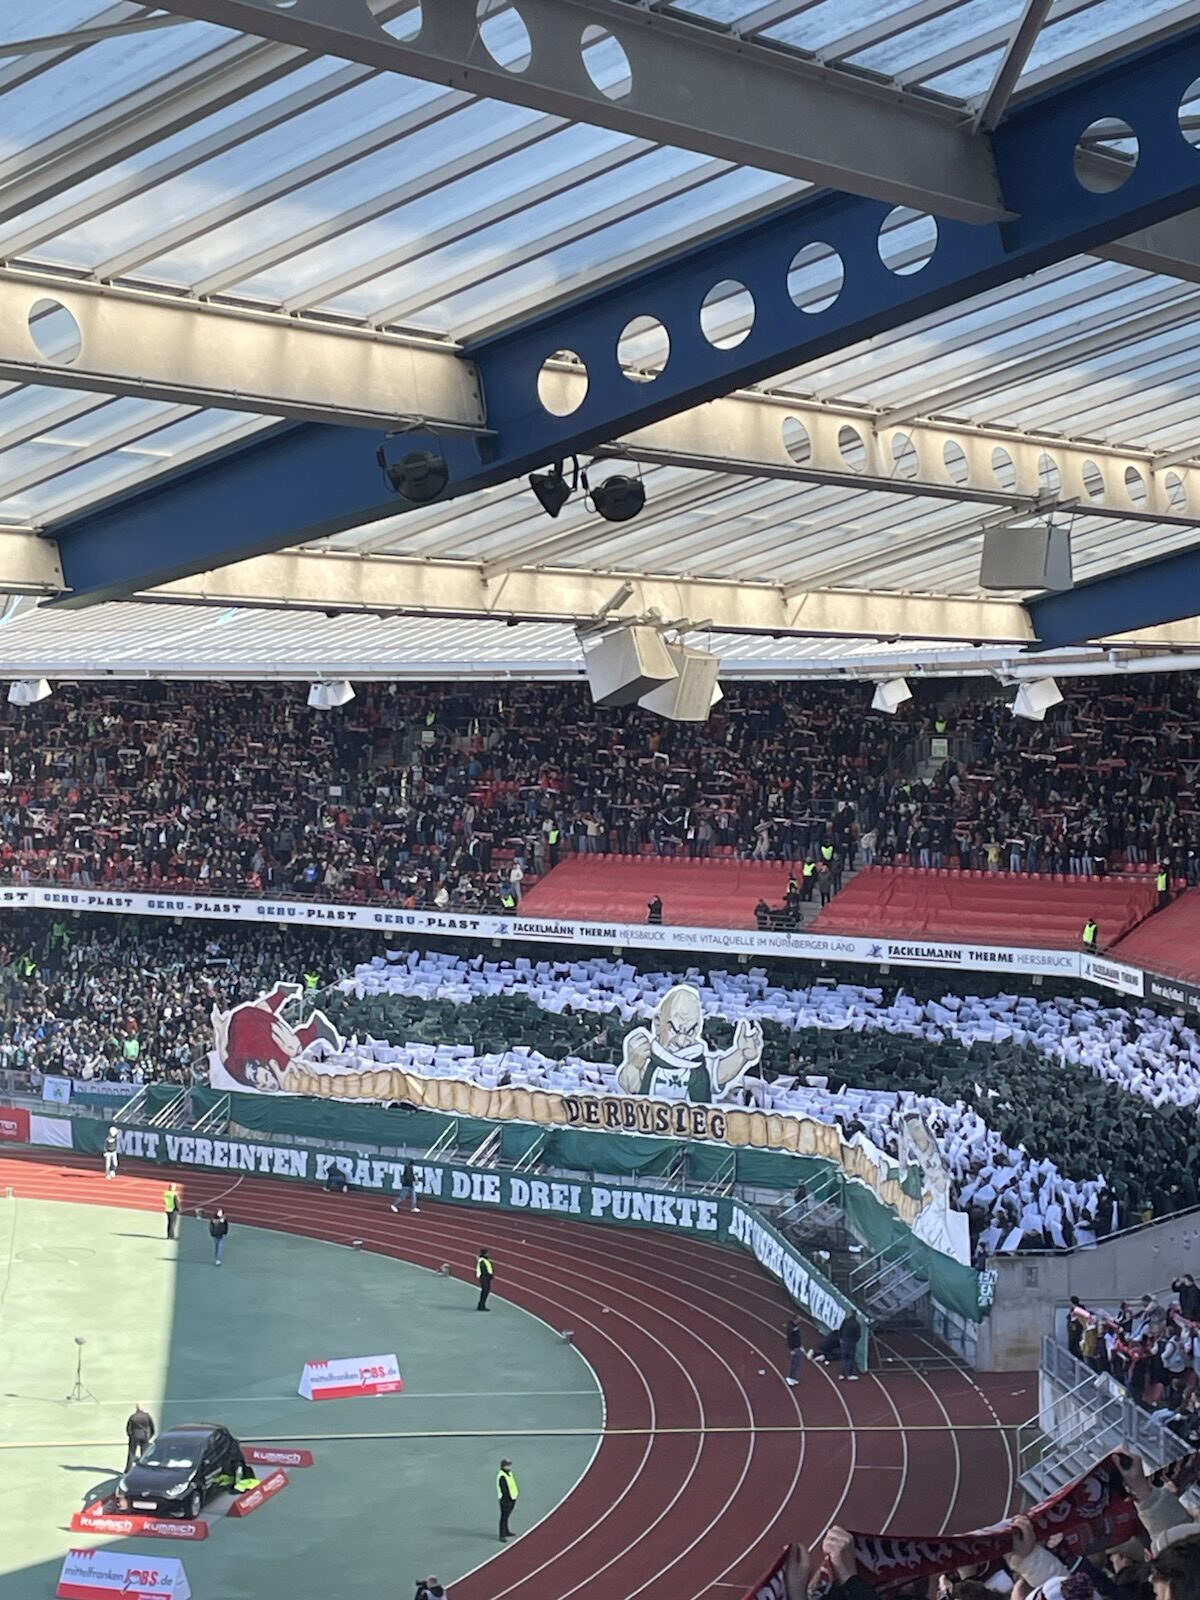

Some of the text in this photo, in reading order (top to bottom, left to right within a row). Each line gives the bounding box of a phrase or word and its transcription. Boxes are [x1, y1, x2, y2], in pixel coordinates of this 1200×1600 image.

[0, 892, 28, 902] ST
[513, 923, 574, 935] FACKELMANN
[580, 927, 617, 938] THERME
[673, 933, 697, 944] MEINE
[700, 934, 755, 947] VITALQUELLE
[757, 938, 767, 947] IM
[831, 942, 855, 952] LAND
[888, 946, 1073, 968] FACKELMANN THERME HERSBRUCK
[565, 1099, 725, 1139] DERBYSIEG
[117, 1130, 159, 1158] MIT
[165, 1135, 308, 1177] VEREINTEN
[316, 1151, 443, 1195] KRÄFTEN
[452, 1171, 500, 1203] DIE
[510, 1178, 581, 1213] DREI
[591, 1187, 718, 1230] PUNKTE
[143, 1521, 196, 1533] kummich
